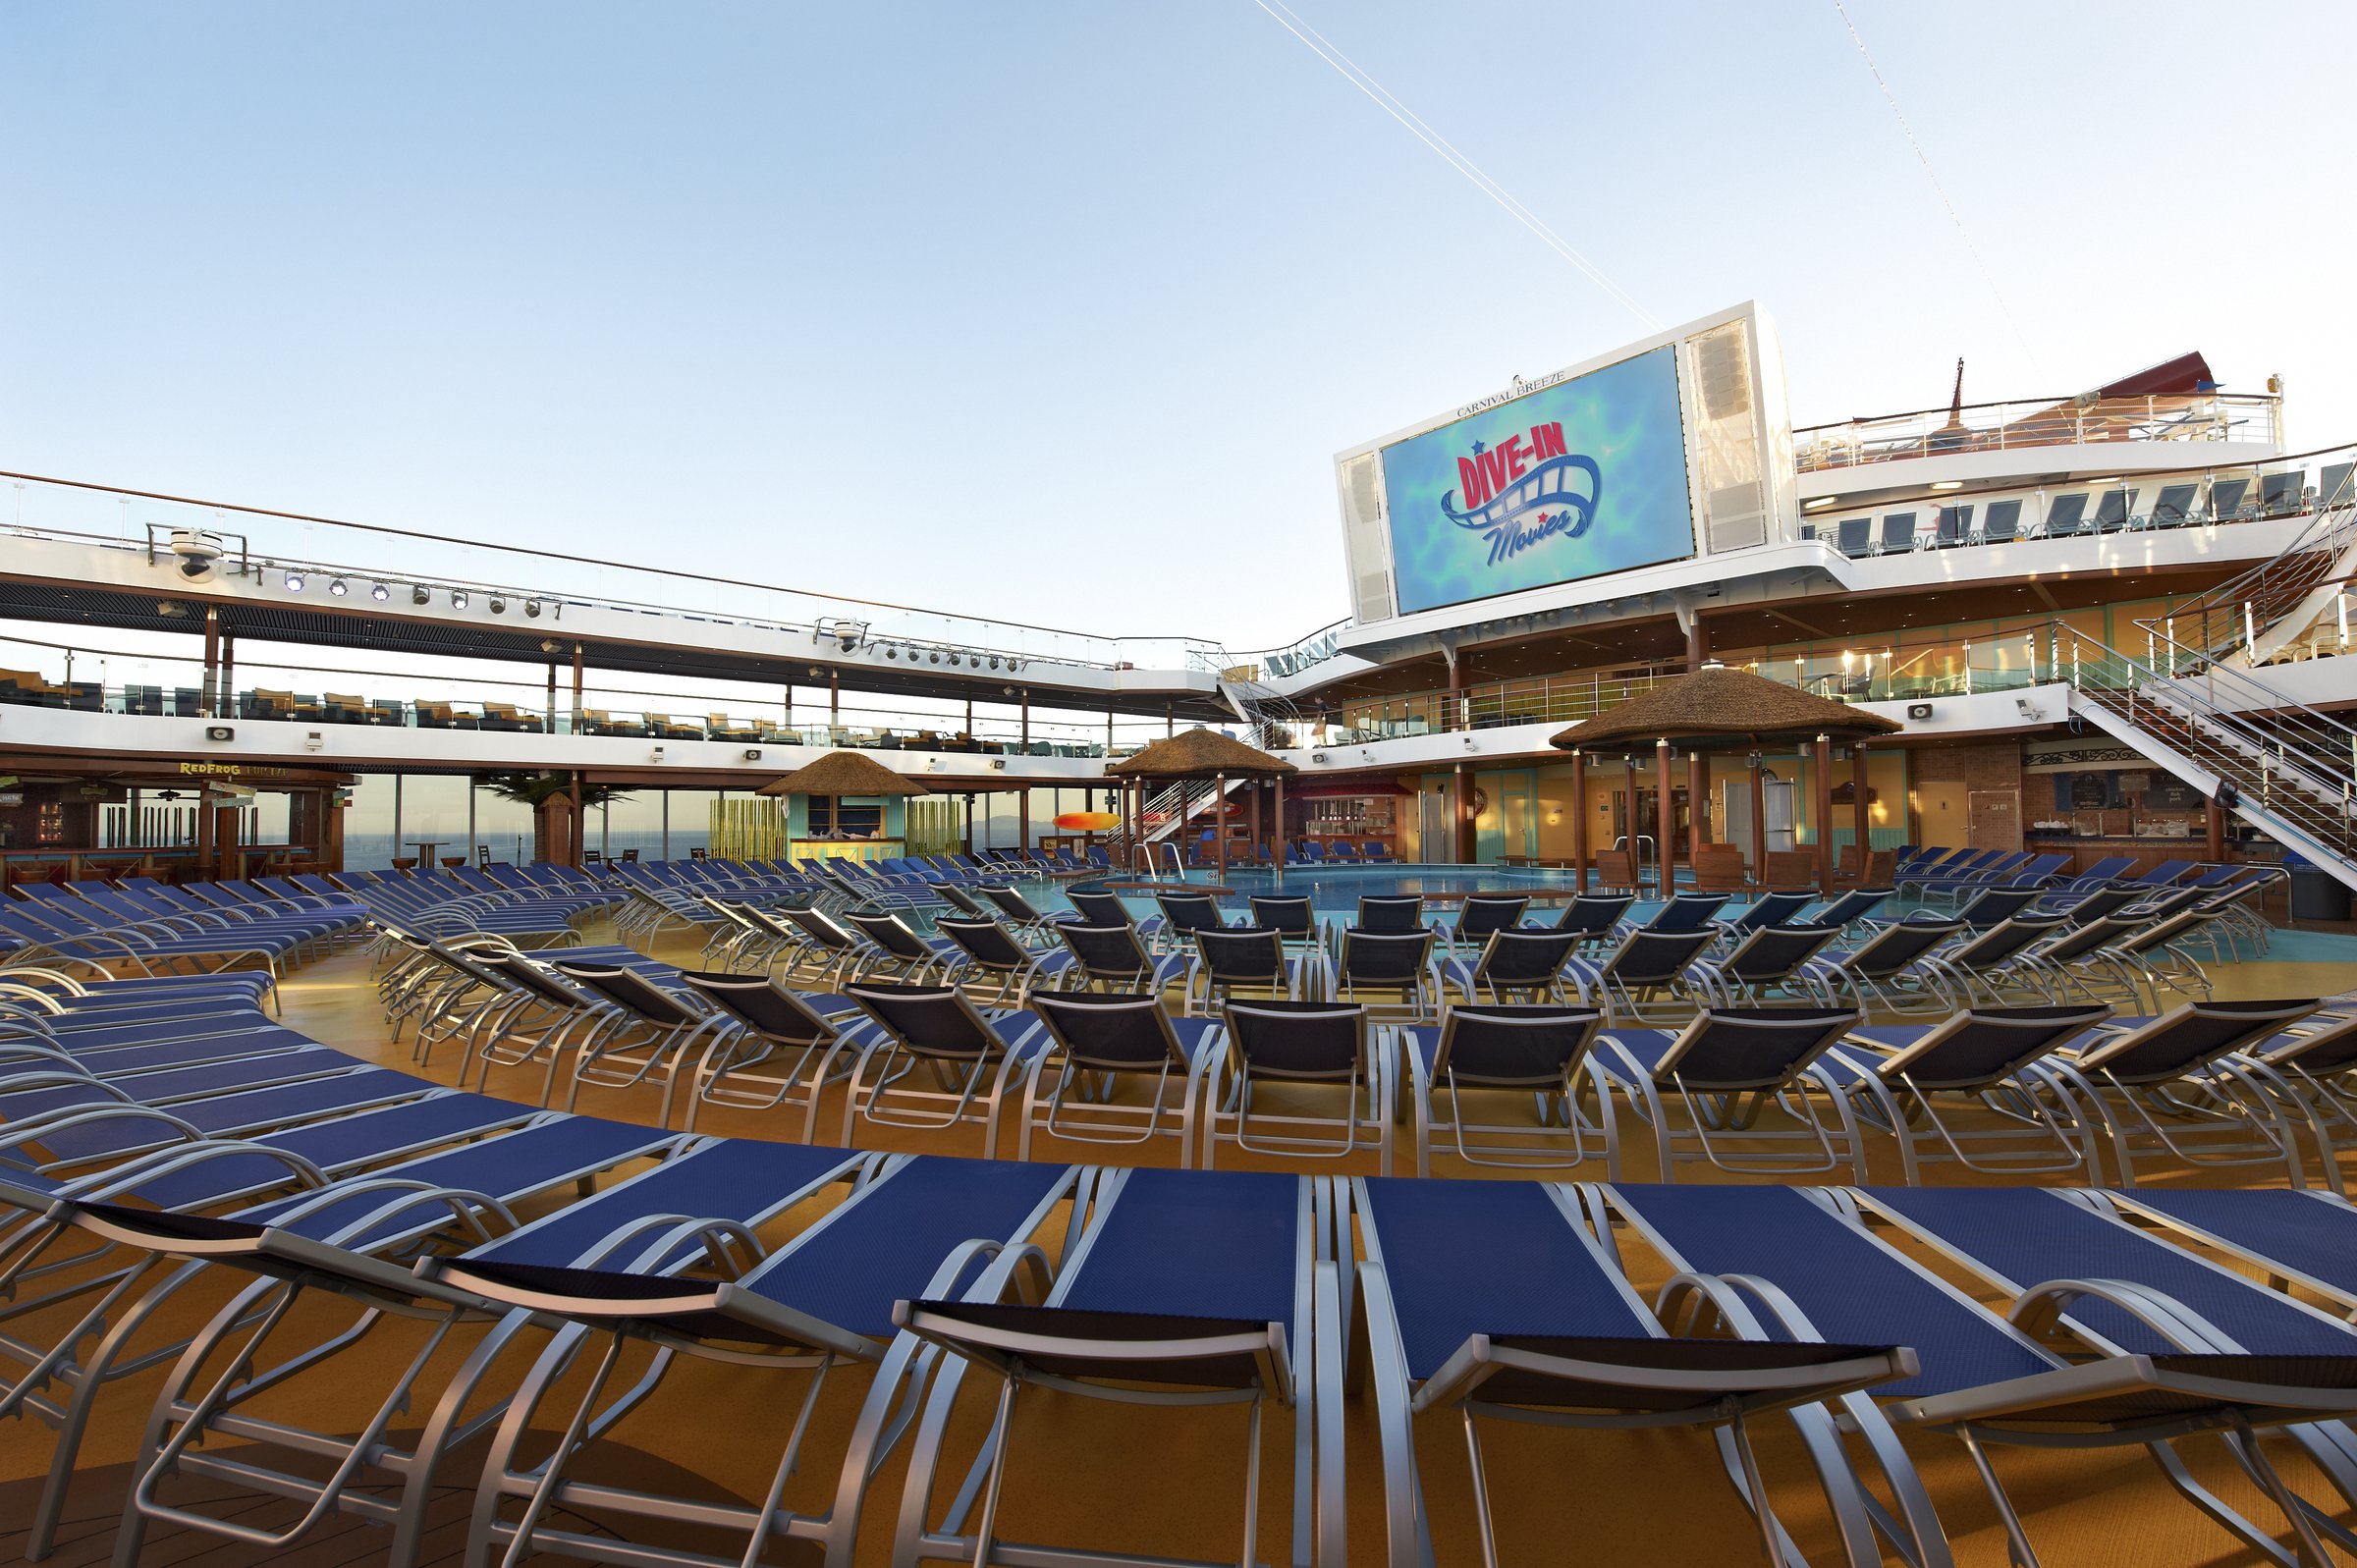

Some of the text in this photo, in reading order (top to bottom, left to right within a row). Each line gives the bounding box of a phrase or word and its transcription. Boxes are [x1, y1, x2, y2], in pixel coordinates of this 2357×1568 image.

[1457, 370, 1565, 417] CARNIVAL BREEZE
[1457, 421, 1568, 510] DIVE-IN
[1482, 510, 1571, 567] Movies
[180, 762, 241, 776] REDFROG
